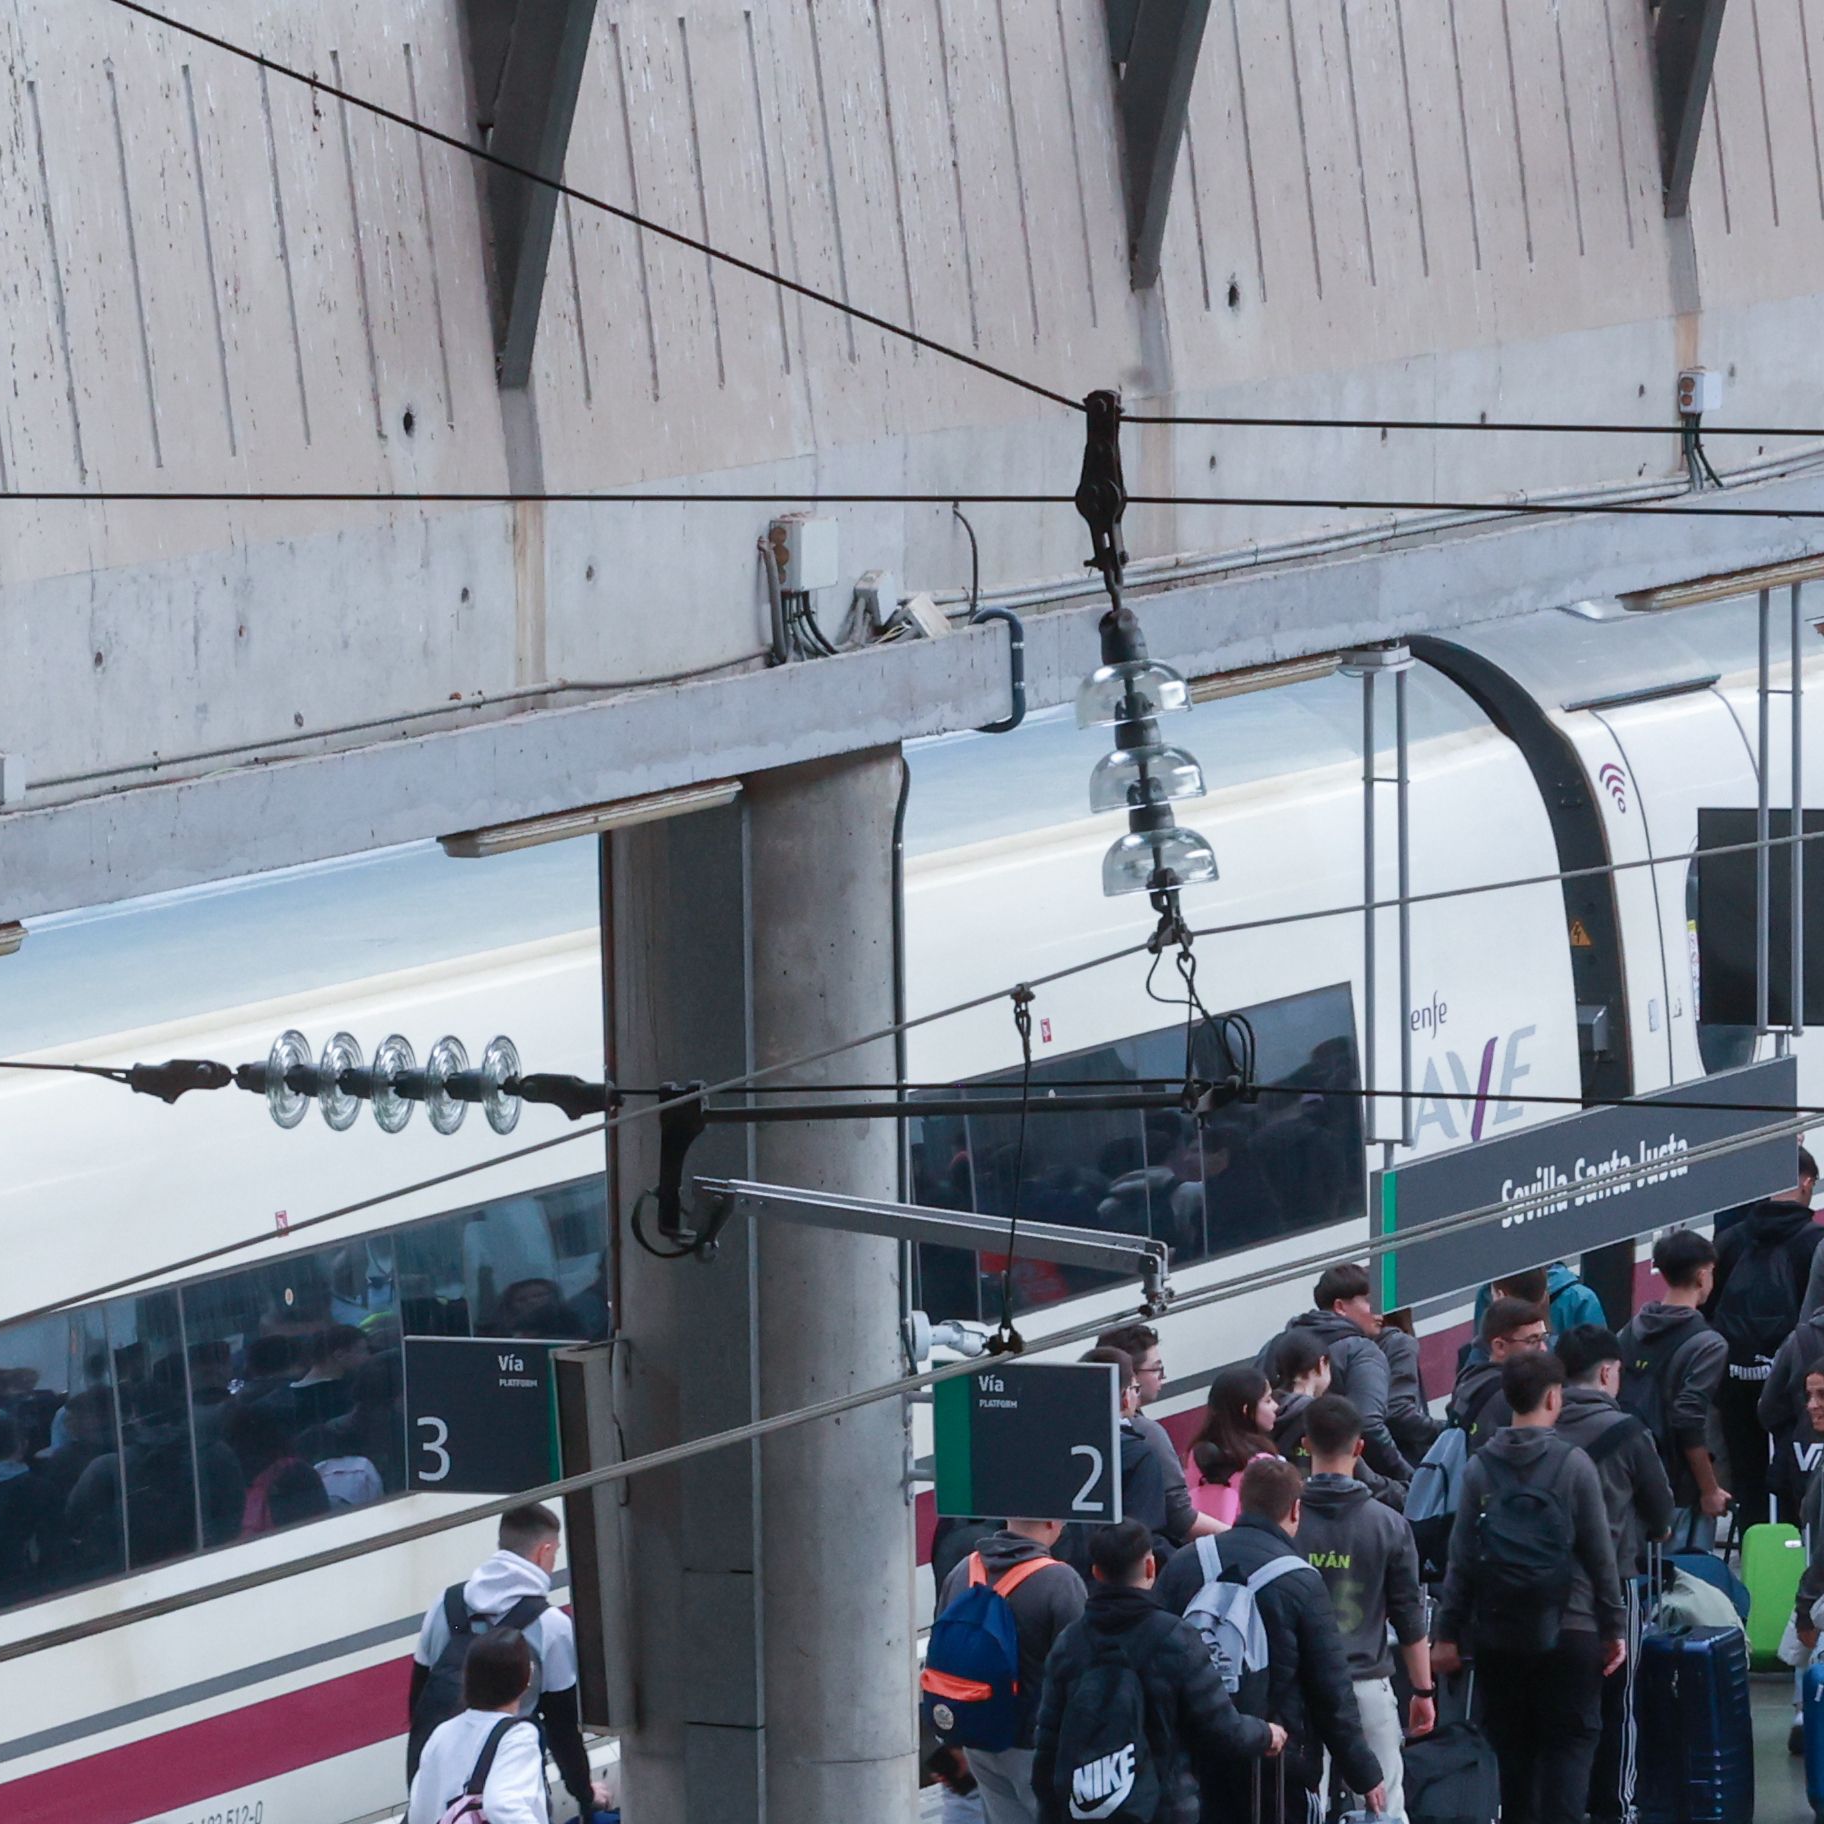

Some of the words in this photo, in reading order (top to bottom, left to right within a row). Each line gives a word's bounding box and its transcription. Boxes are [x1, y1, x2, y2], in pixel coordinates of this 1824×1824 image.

[1410, 990, 1448, 1039] enfe
[1411, 1024, 1537, 1151] AVE
[497, 1354, 525, 1372] Vía
[498, 1379, 538, 1388] PLATFORM
[978, 1375, 1005, 1392] Vía
[979, 1399, 1018, 1409] PLATFORM
[416, 1416, 451, 1481] 3
[1070, 1445, 1104, 1512] 2
[1308, 1550, 1351, 1569] IVÁN
[1073, 1743, 1135, 1806] NIKE
